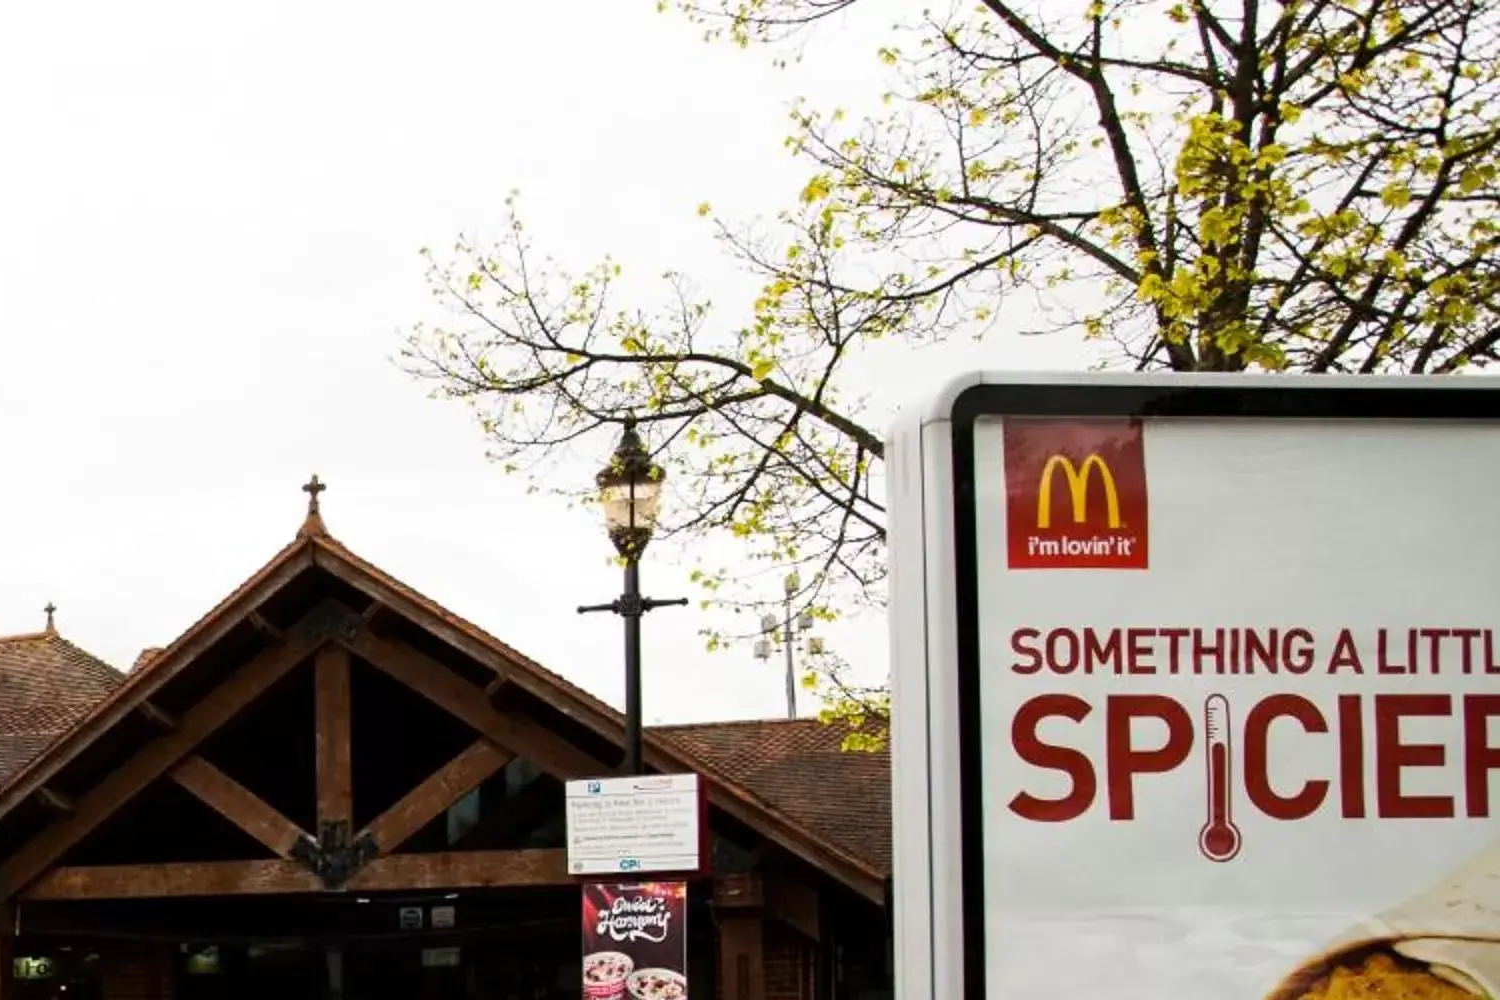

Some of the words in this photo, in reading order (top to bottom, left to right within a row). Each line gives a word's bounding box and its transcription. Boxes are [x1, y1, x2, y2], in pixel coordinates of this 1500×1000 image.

[1028, 536, 1059, 555] i'm
[1062, 536, 1115, 555] lovin'
[1117, 536, 1132, 555] it
[1011, 627, 1315, 676] SOMETHING
[1327, 628, 1364, 675] A
[596, 909, 671, 942] Harmony
